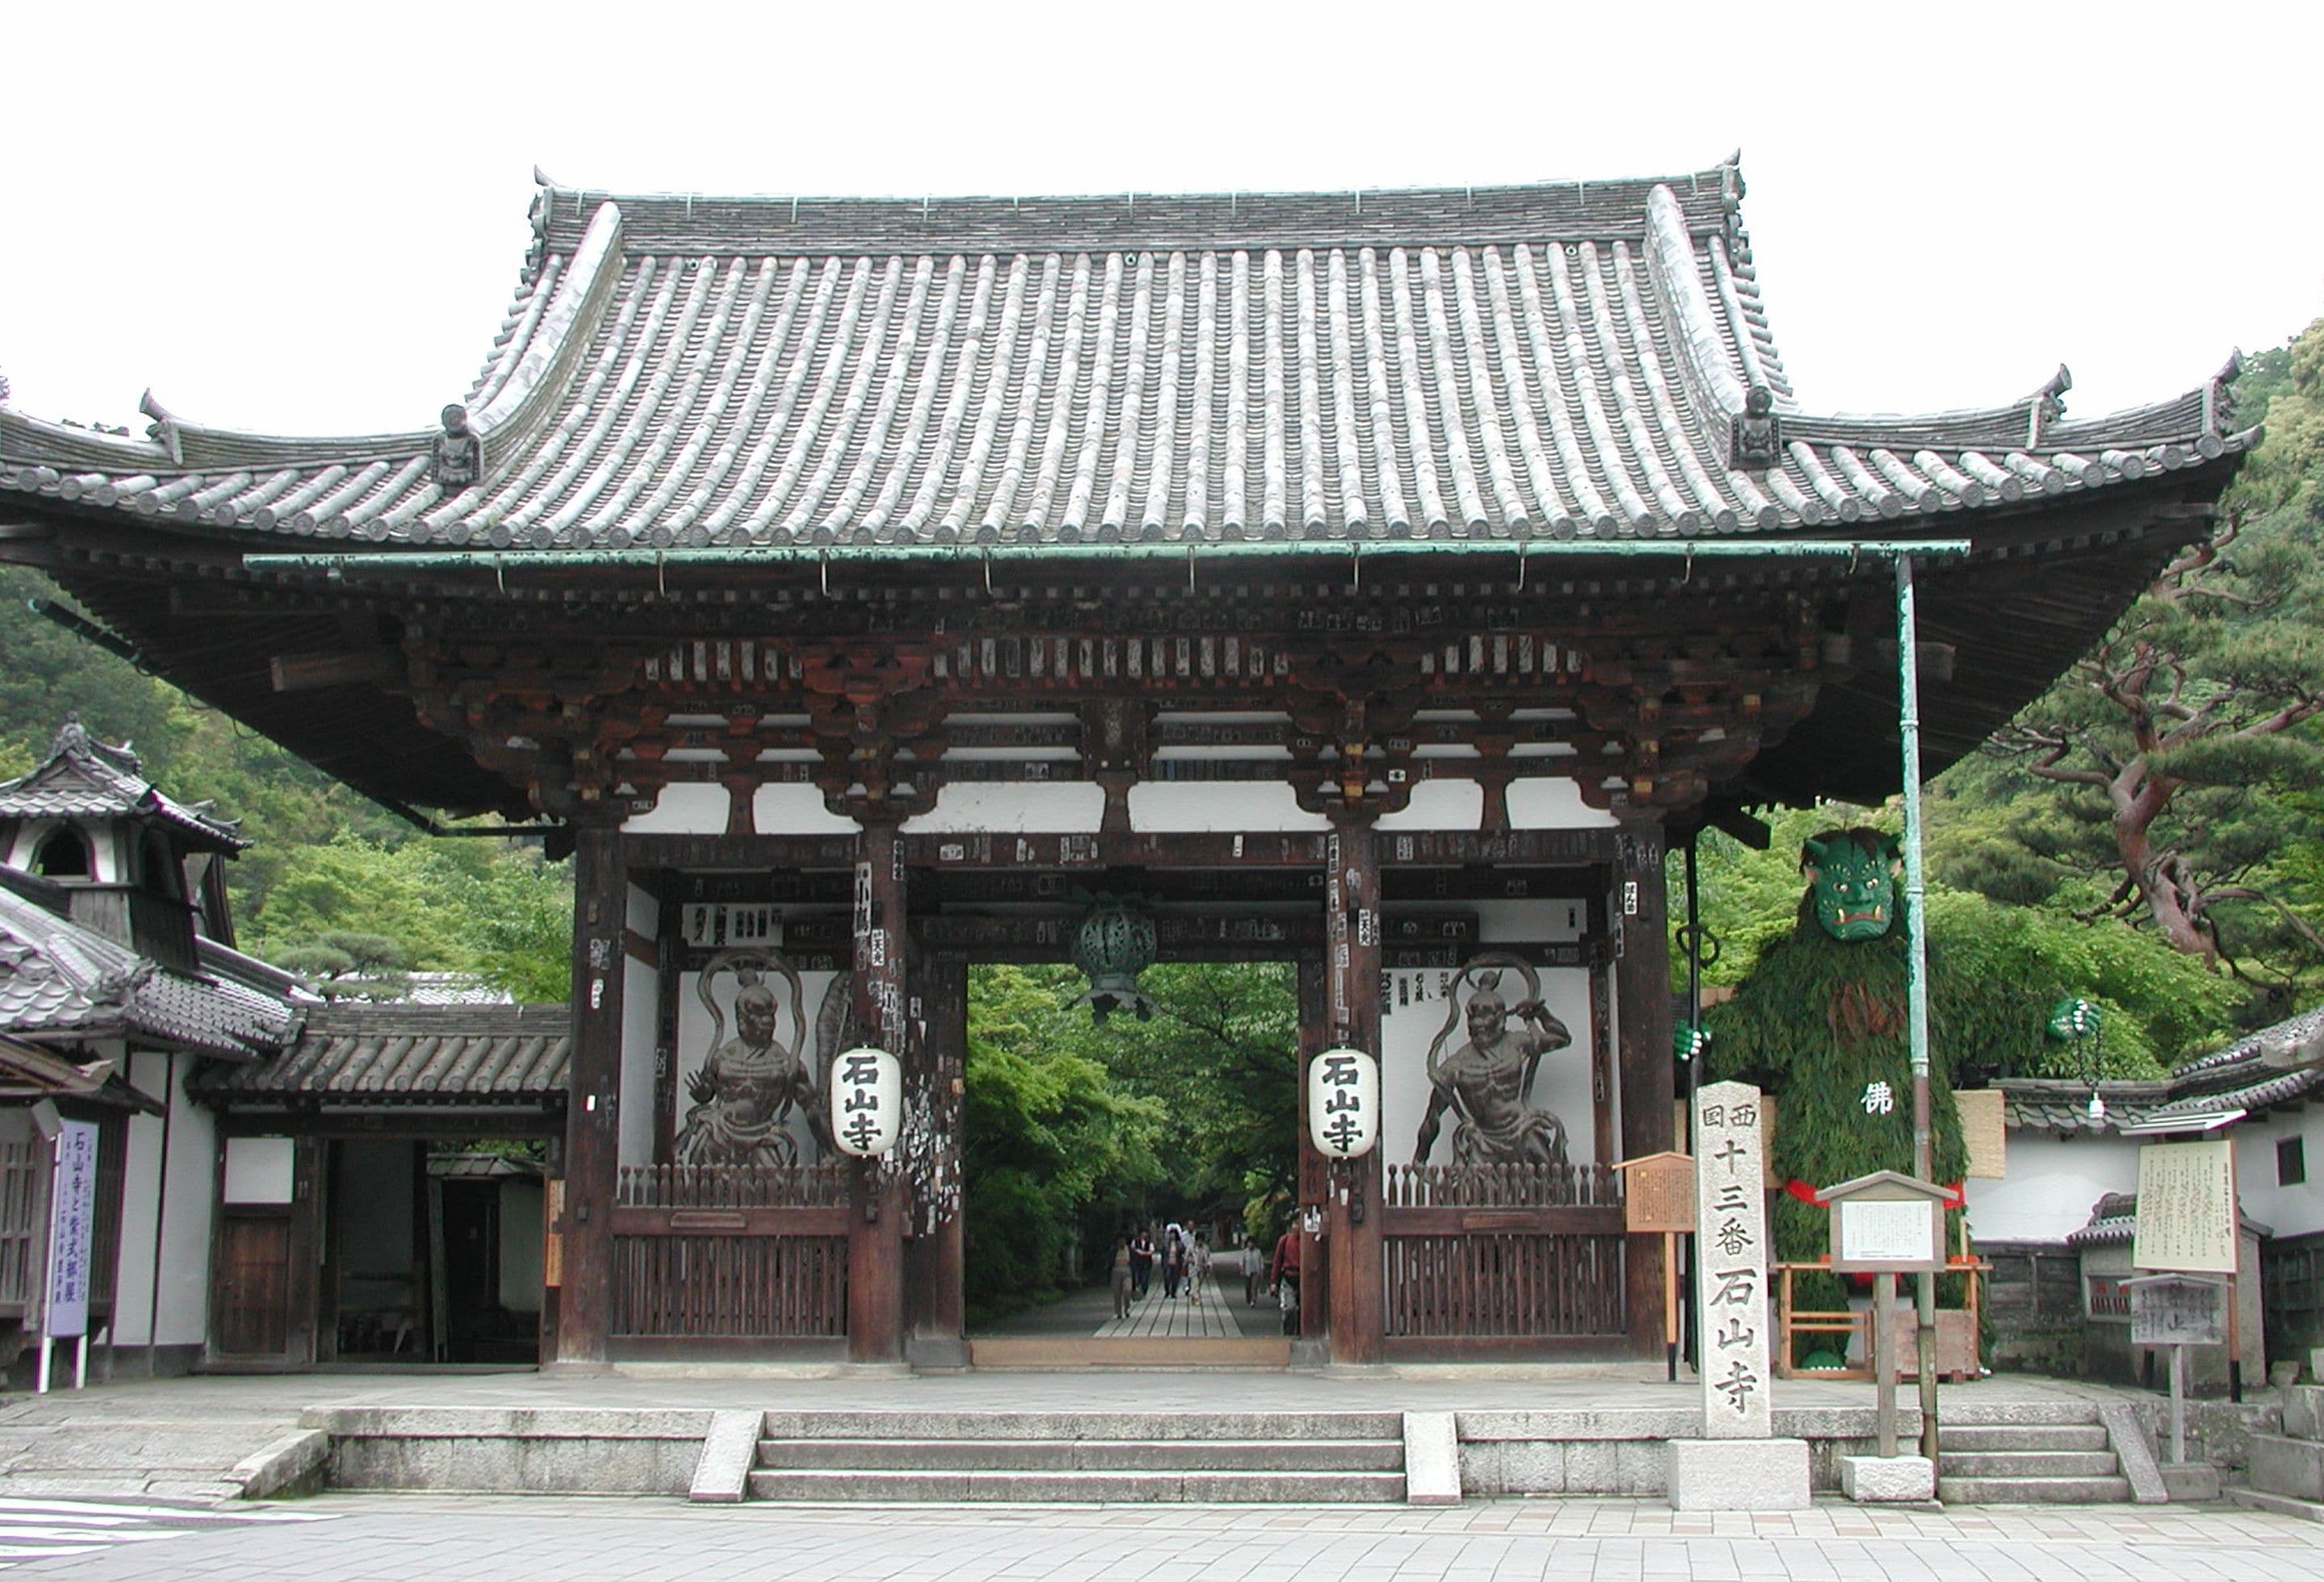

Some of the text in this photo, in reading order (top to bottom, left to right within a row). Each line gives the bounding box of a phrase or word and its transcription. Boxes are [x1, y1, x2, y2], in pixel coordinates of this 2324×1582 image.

[842, 1055, 882, 1151] 石山寺
[1323, 1056, 1363, 1154] 石山寺
[1860, 1081, 1894, 1115] 佛
